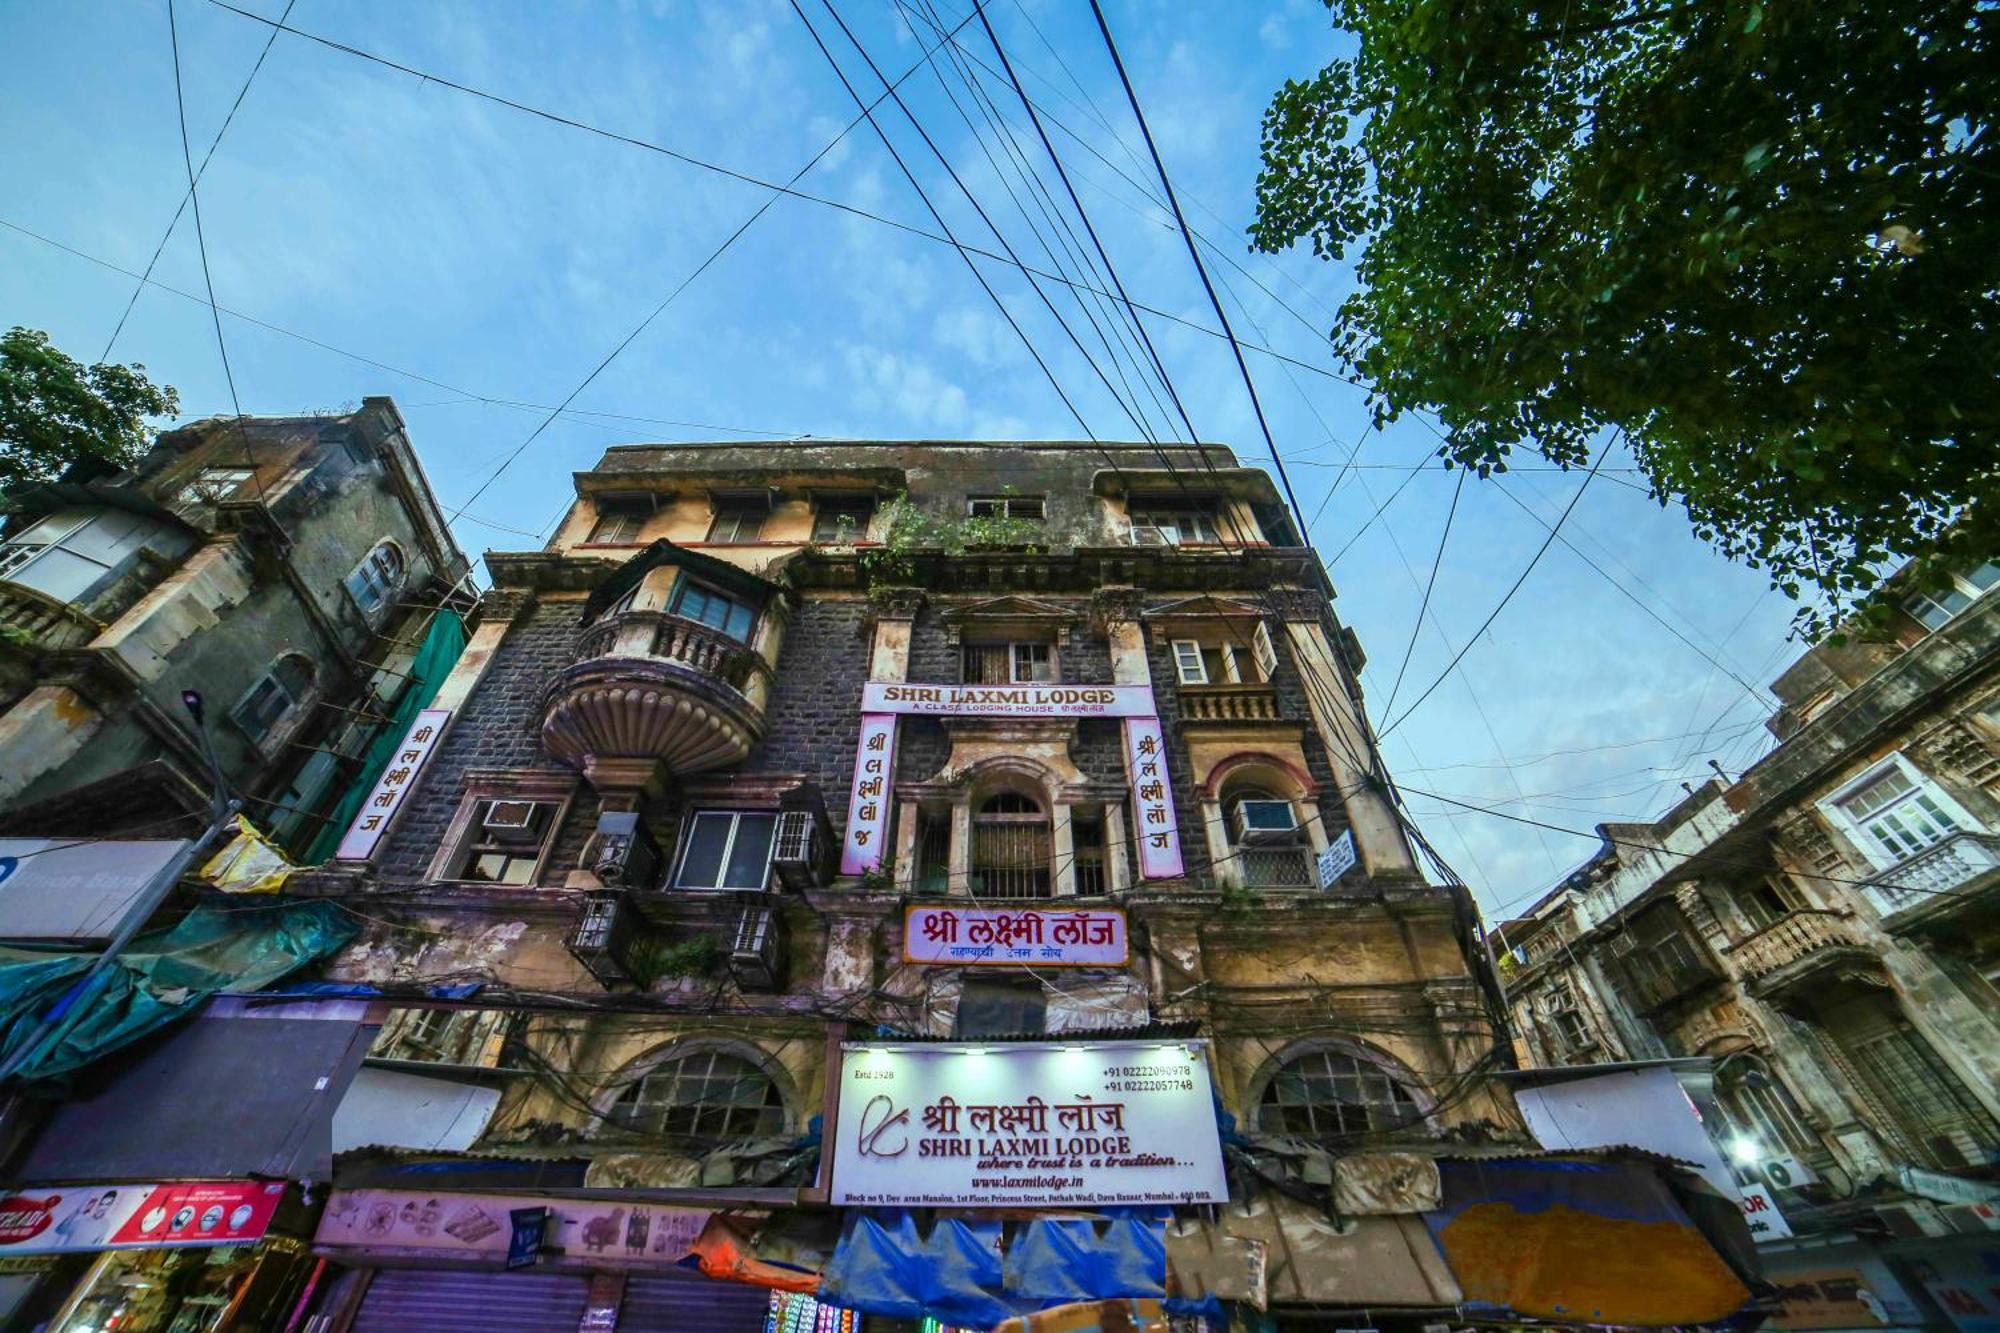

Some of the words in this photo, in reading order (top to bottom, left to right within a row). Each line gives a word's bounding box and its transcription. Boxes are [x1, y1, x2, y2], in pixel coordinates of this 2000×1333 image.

[884, 686, 941, 703] SHRI
[949, 689, 1029, 705] LAXMI
[1035, 689, 1115, 705] LODGE
[925, 703, 962, 712] CLASS
[966, 704, 1012, 712] LODGING
[1016, 705, 1054, 713] HOUSE
[411, 726, 434, 743] श्री
[1137, 735, 1155, 755] श्री
[922, 911, 959, 943] श्री
[966, 912, 1045, 948] लक्ष्मी
[1051, 913, 1116, 945] लॉज
[1103, 1067, 1120, 1077] +91
[1105, 1082, 1121, 1092] +91
[921, 1096, 961, 1134] श्री
[967, 1096, 1049, 1136] लक्ष्मी
[1054, 1094, 1125, 1132] लॉज
[918, 1138, 972, 1157] SHRI
[978, 1138, 1048, 1157] LAXMI
[1056, 1136, 1131, 1155] LODGE
[977, 1157, 1023, 1169] where
[1027, 1156, 1066, 1168] trust
[1069, 1155, 1083, 1168] is
[1090, 1158, 1101, 1168] a
[972, 1175, 1084, 1190] www.laxmilodge.in
[845, 1194, 866, 1202] Block
[923, 1194, 954, 1203] Mansion,
[957, 1194, 968, 1203] 1st
[969, 1194, 990, 1204] Floor,
[991, 1193, 1022, 1203] Princess
[1024, 1194, 1047, 1203] Street,
[1144, 1191, 1174, 1201] Mumbai
